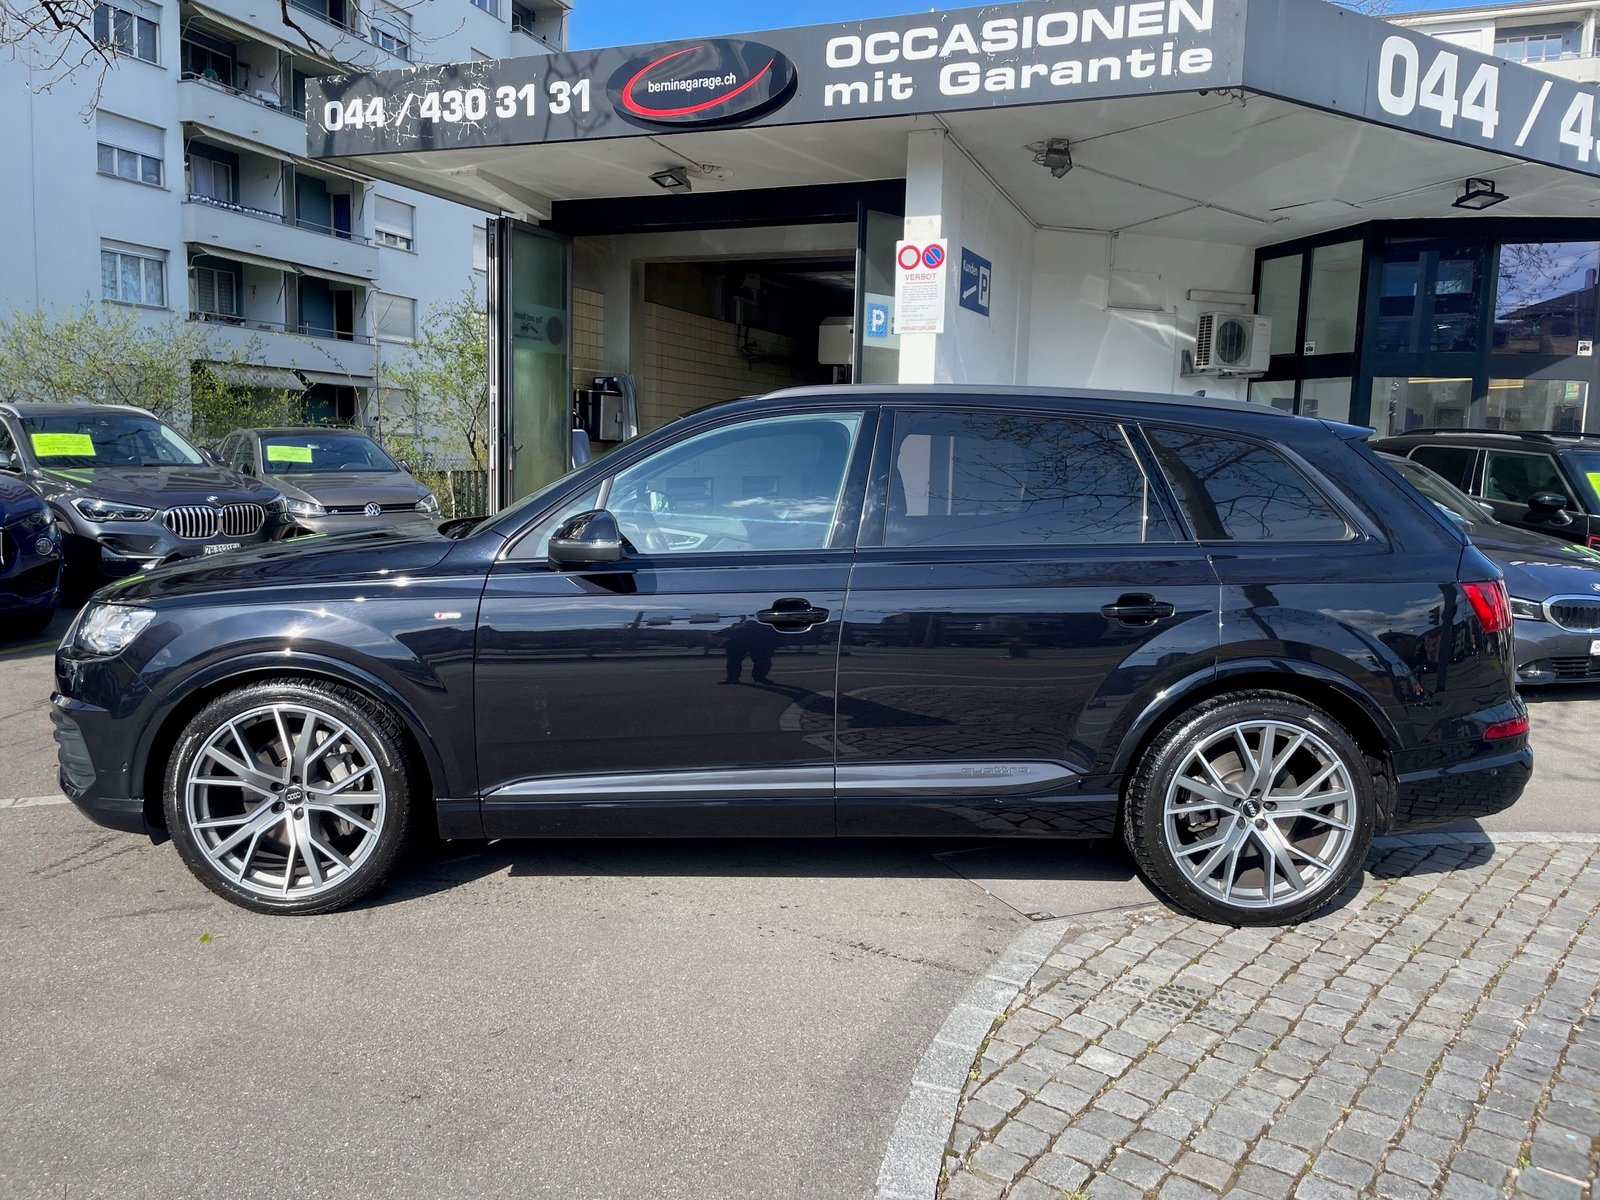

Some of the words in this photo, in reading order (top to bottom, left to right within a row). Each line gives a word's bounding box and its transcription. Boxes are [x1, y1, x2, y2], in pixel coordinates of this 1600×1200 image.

[825, 0, 1214, 69] OCCASIONEN
[647, 72, 737, 94] berninagarage.ch
[824, 71, 914, 107] mit
[939, 41, 1213, 96] Garantie
[323, 97, 386, 132] 044
[420, 88, 486, 124] 430
[495, 83, 536, 118] 31
[549, 78, 590, 114] 31
[1377, 35, 1499, 140] 044
[1559, 91, 1600, 163] 4
[905, 272, 937, 281] VERBOT
[980, 273, 989, 301] P
[871, 308, 886, 332] P
